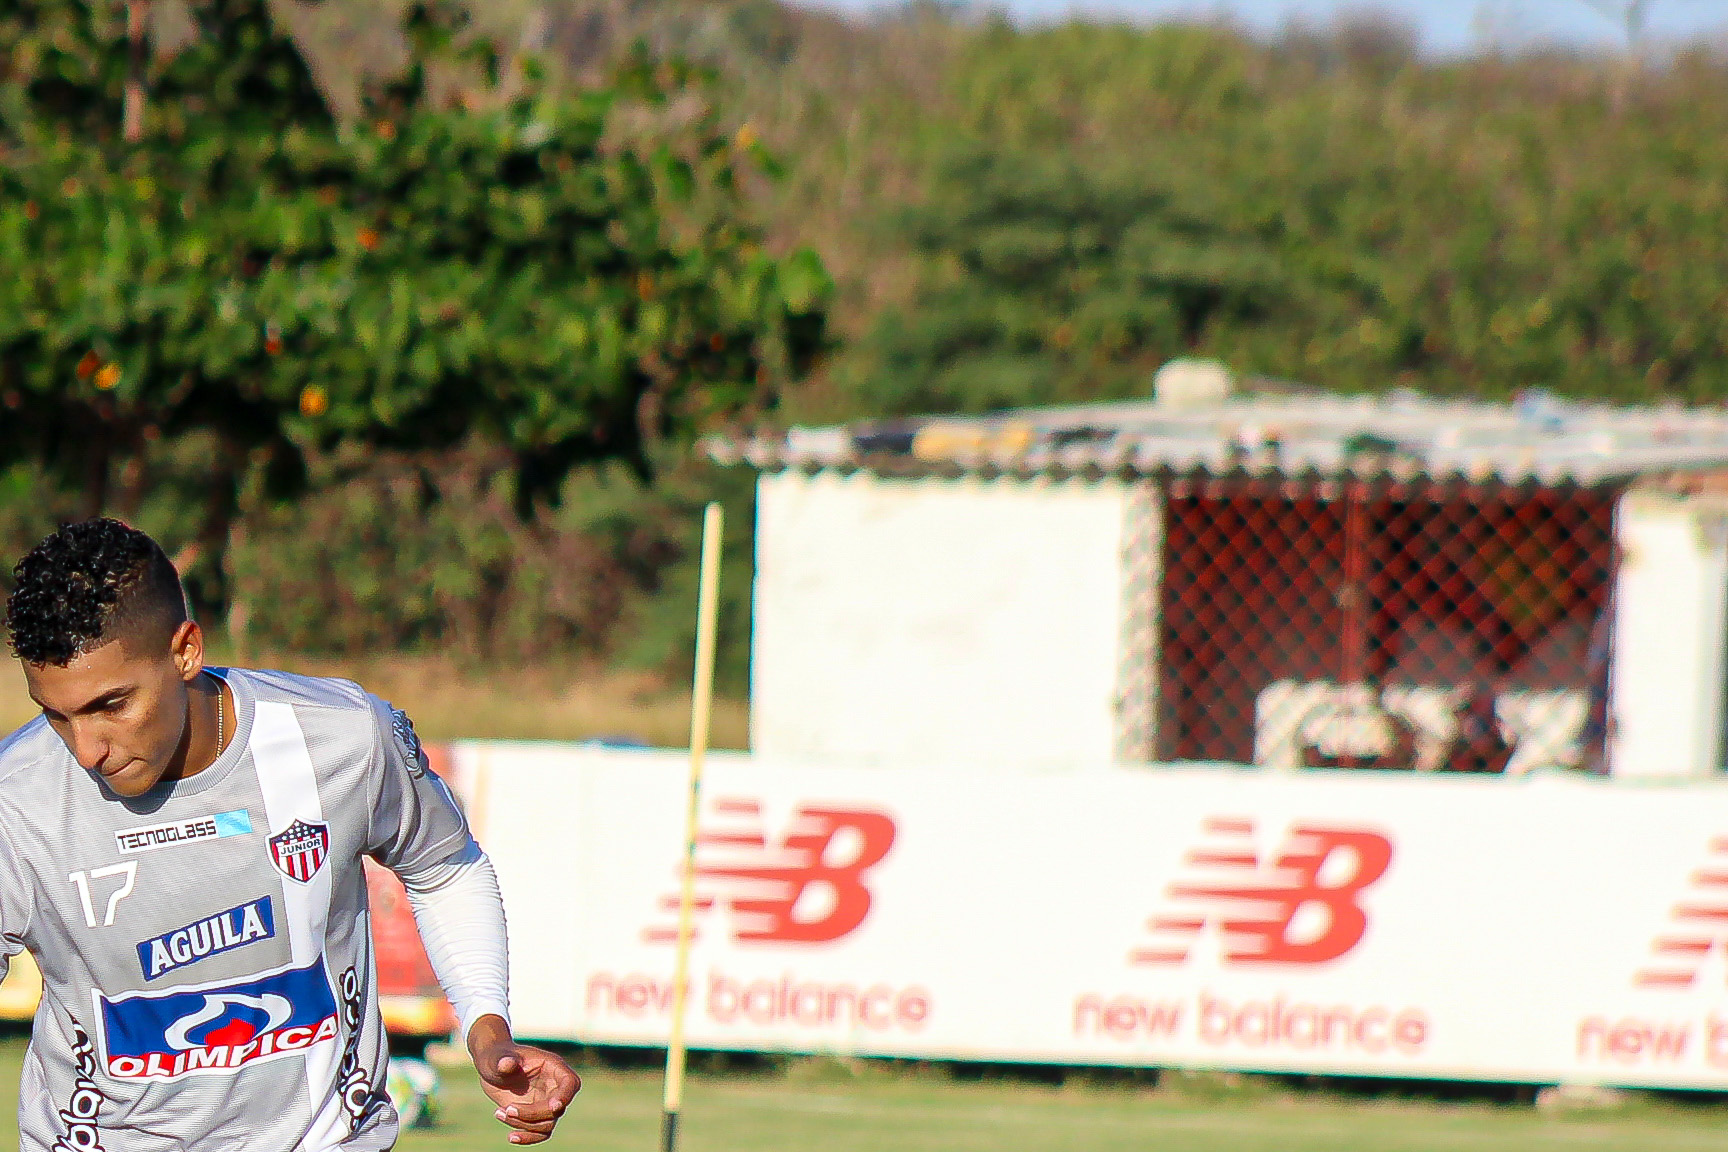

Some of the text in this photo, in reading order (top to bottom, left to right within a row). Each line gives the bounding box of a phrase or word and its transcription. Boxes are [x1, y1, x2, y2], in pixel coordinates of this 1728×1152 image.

[279, 838, 322, 856] JUNIOR
[68, 860, 139, 928] 17
[149, 903, 268, 976] AGUILA
[586, 968, 932, 1030] new balance
[1075, 988, 1431, 1054] new balance
[108, 1014, 338, 1077] OLIMPICA
[1577, 1012, 1688, 1060] new
